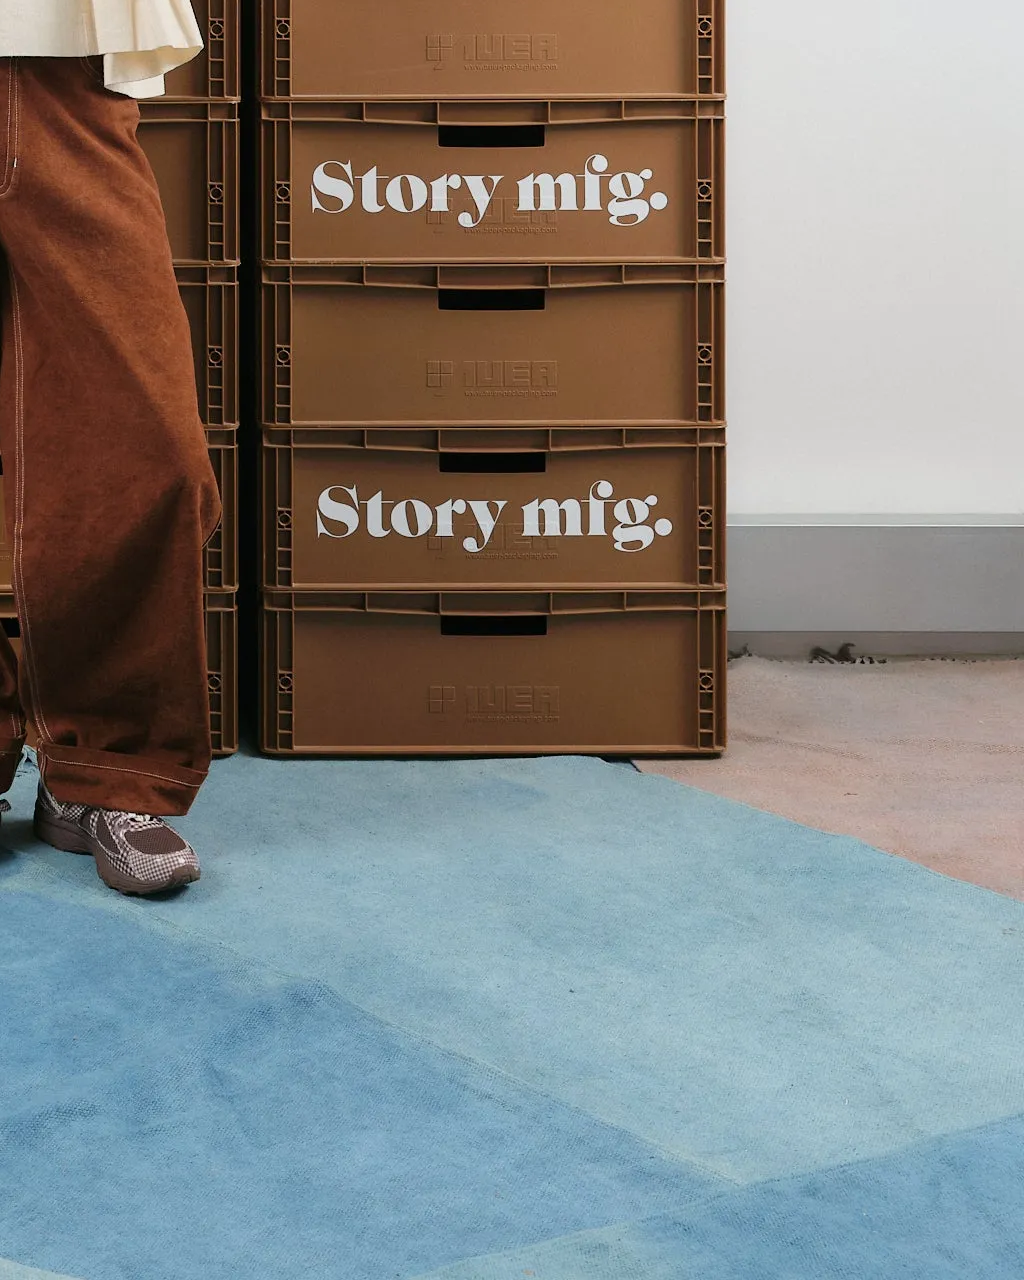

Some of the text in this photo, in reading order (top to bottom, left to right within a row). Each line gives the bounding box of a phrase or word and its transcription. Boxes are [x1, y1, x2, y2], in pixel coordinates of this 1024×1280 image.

[310, 154, 669, 228] Story mfg.
[316, 480, 674, 553] Story mfg.
